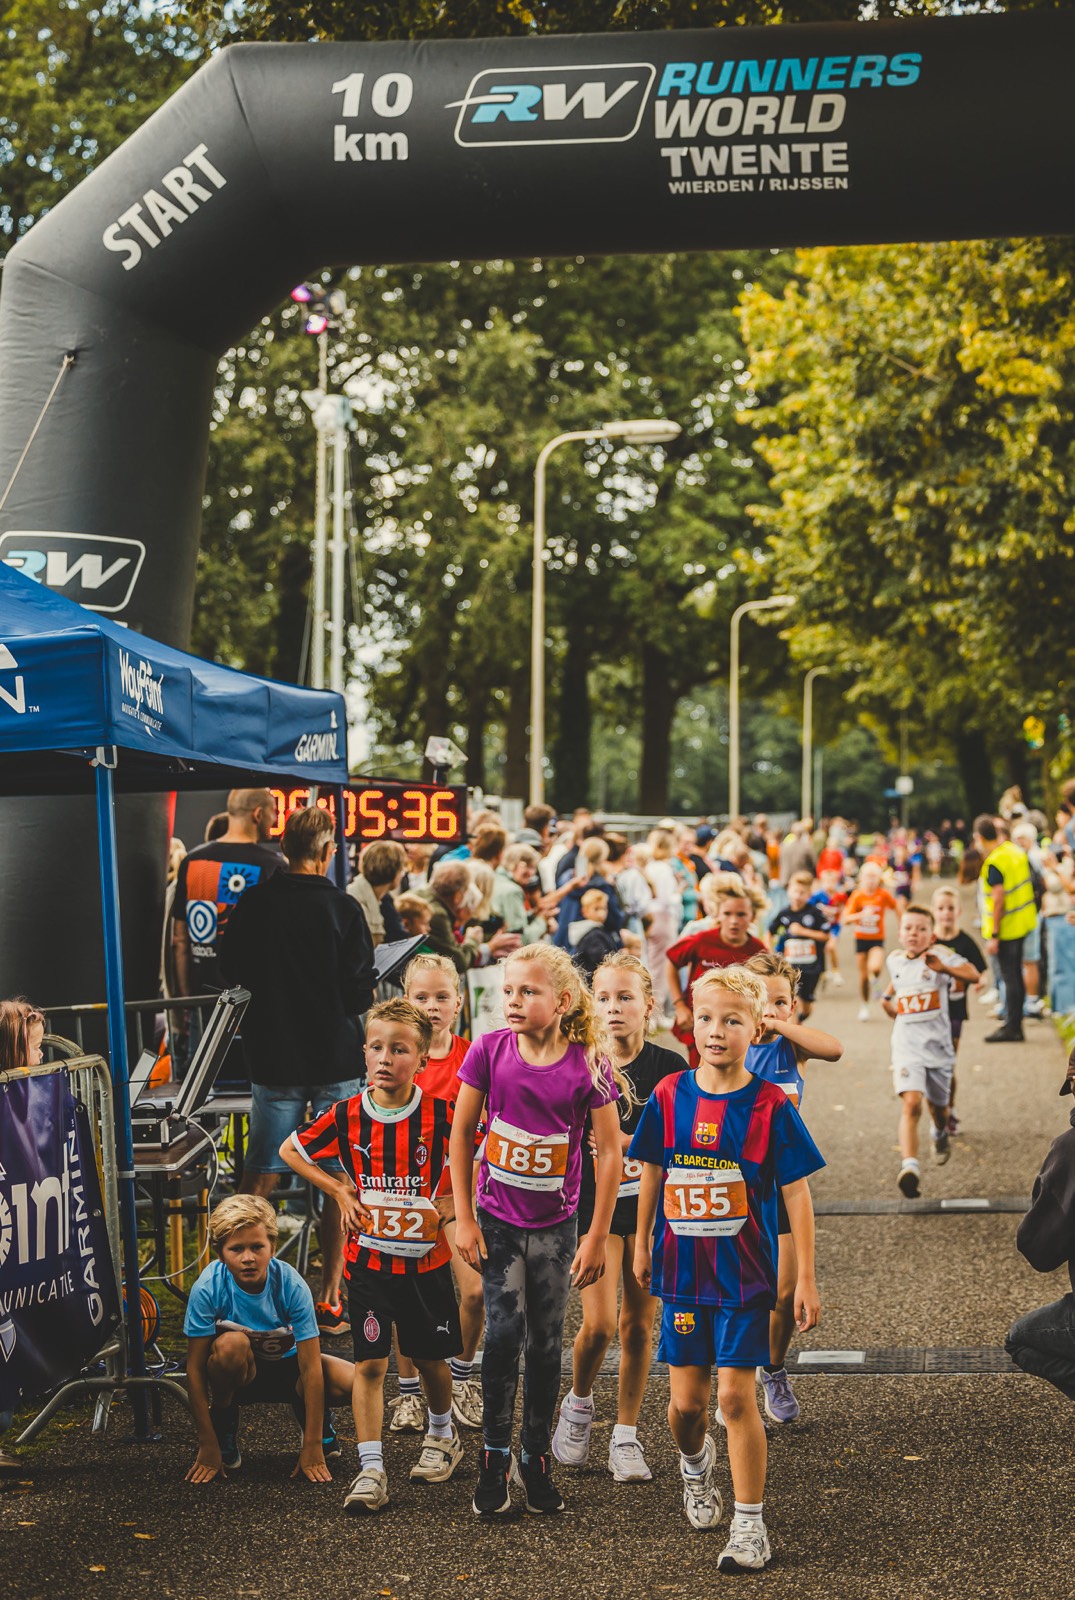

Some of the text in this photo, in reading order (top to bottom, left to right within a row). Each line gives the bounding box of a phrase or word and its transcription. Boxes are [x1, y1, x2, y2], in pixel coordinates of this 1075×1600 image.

[658, 53, 922, 96] RUNNERS
[332, 73, 413, 118] 10
[471, 80, 639, 123] RW
[654, 94, 847, 138] WORLD
[334, 125, 408, 162] km
[661, 142, 849, 177] TWENTE
[668, 180, 754, 194] WIERDEN
[769, 177, 848, 191] RIJSSEN
[102, 143, 227, 271] START
[295, 733, 339, 762] GARMIN
[900, 994, 932, 1013] 147
[498, 1140, 552, 1174] 185
[674, 1154, 683, 1165] FC
[358, 1173, 428, 1188] Emirates
[675, 1187, 731, 1217] 155
[68, 1130, 104, 1326] GARMIN
[369, 1208, 424, 1239] 132
